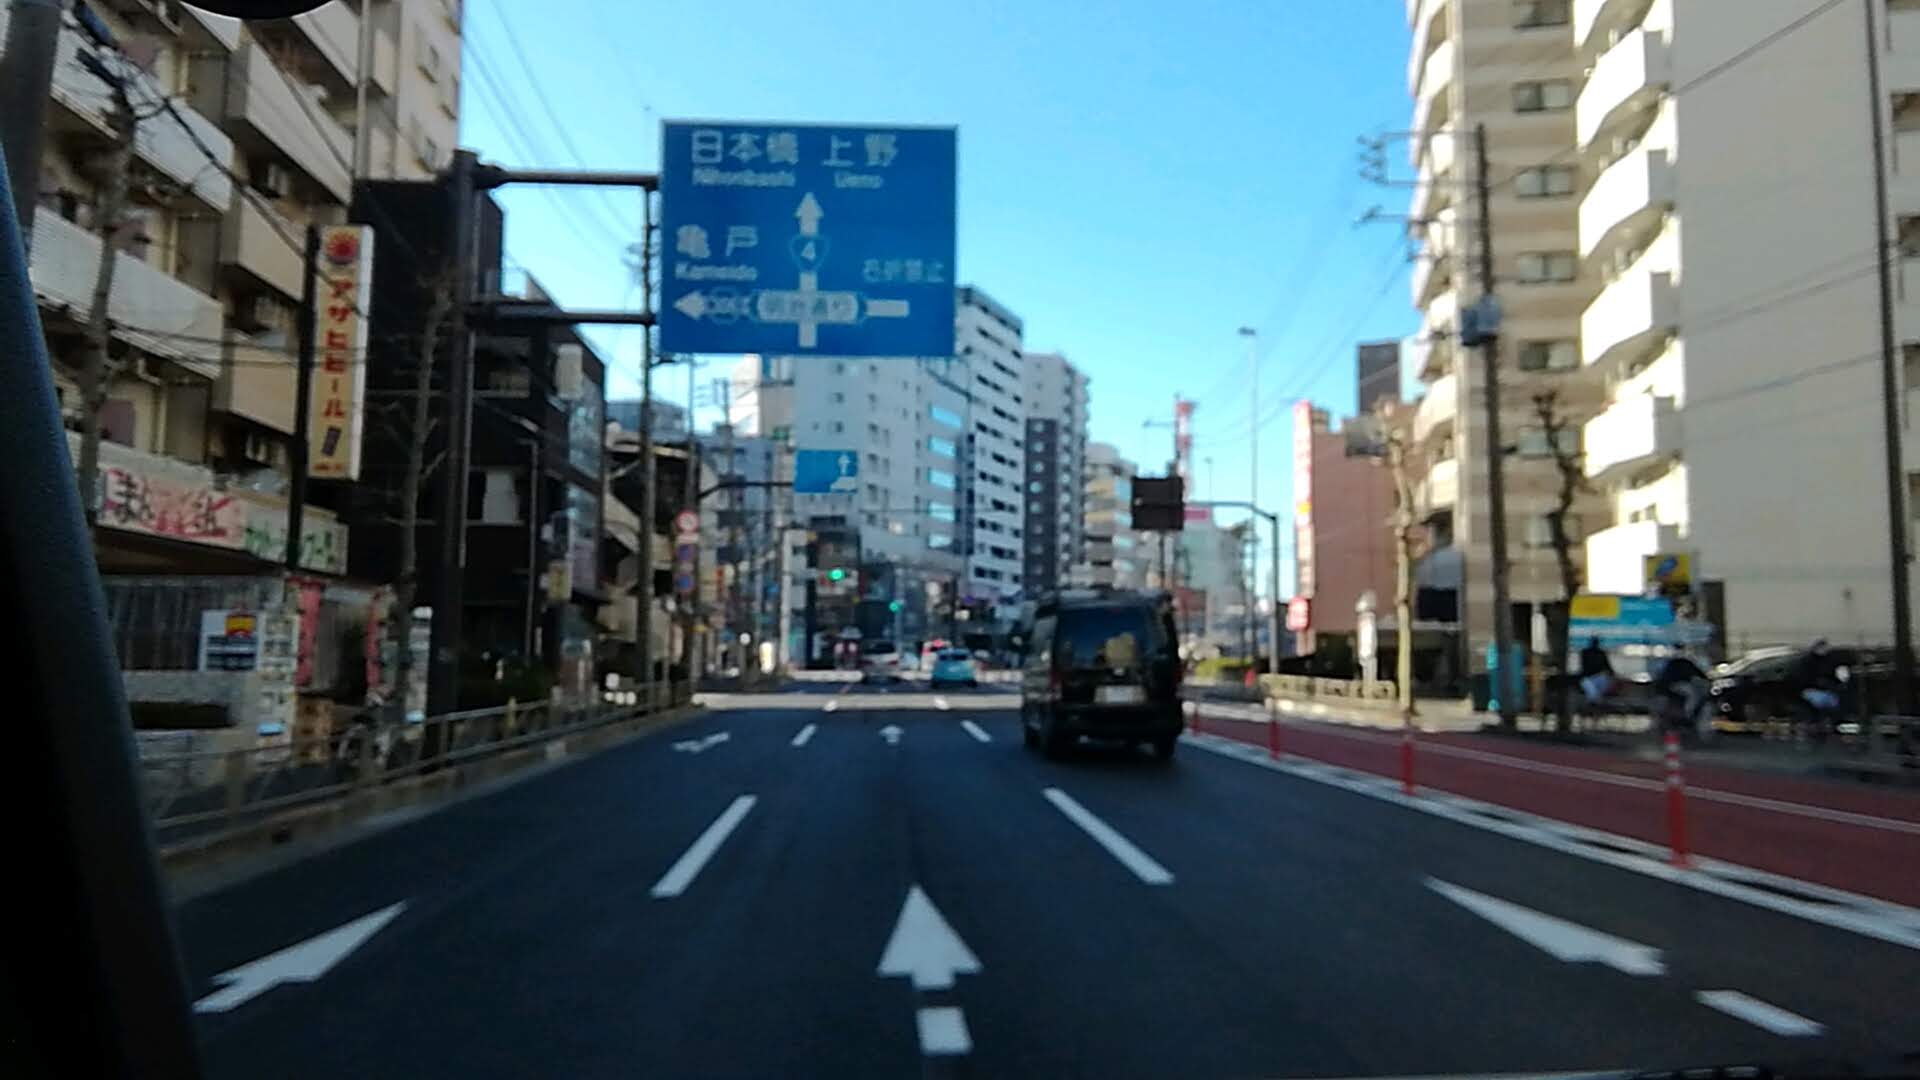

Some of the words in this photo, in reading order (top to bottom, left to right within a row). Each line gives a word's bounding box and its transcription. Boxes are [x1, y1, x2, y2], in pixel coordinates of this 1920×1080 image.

[691, 129, 799, 165] 日本橋
[821, 133, 899, 168] 上野
[834, 171, 884, 189] Ueno
[675, 223, 760, 259] 亀戸
[801, 240, 816, 261] 4
[320, 277, 352, 419] アサヒビール
